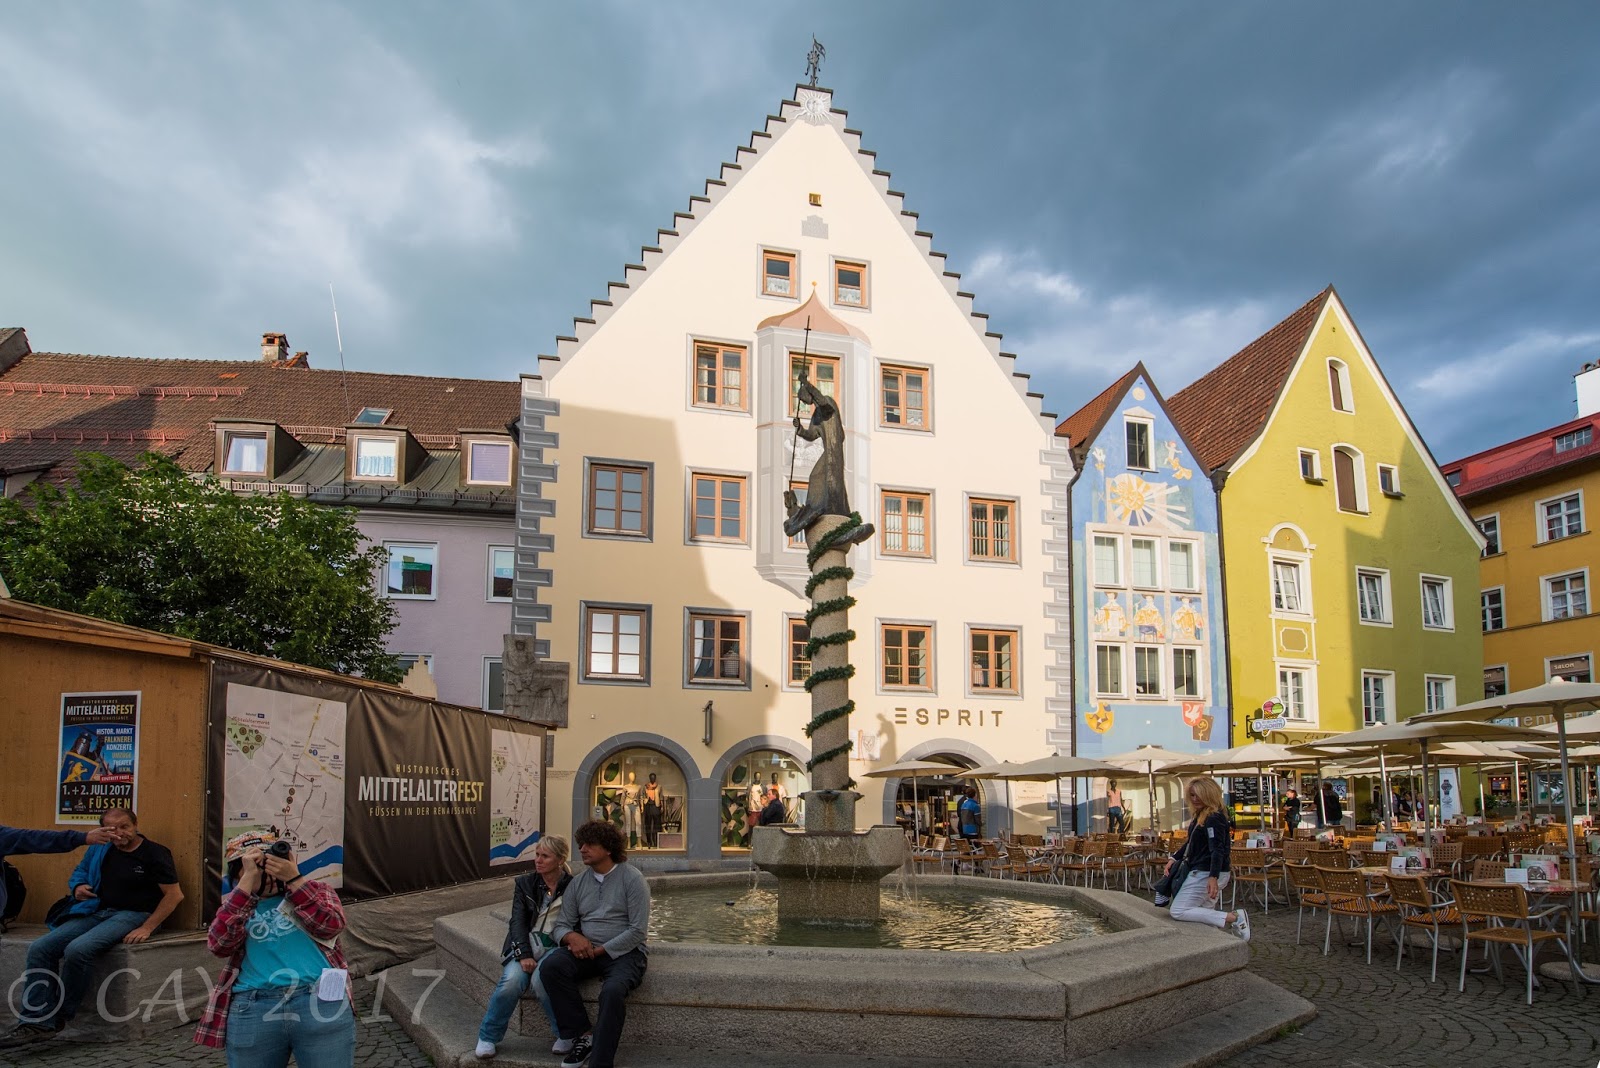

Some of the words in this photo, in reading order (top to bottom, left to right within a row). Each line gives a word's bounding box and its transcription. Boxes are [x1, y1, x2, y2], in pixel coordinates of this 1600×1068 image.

[66, 704, 134, 715] MITTELALTERFEST
[894, 707, 1003, 727] ESPRIT
[396, 764, 460, 776] HISTORISCHES
[62, 785, 70, 795] 1.
[72, 786, 79, 795] +
[81, 785, 89, 795] 2.
[90, 785, 108, 795] JULI
[109, 785, 131, 795] 2017
[358, 776, 484, 802] MITTELALTERFEST
[89, 796, 131, 809] FÜSSEN
[369, 806, 401, 817] FÜSSEN
[404, 808, 413, 816] IN
[416, 807, 430, 816] DER
[433, 806, 476, 815] RENAISSANCE
